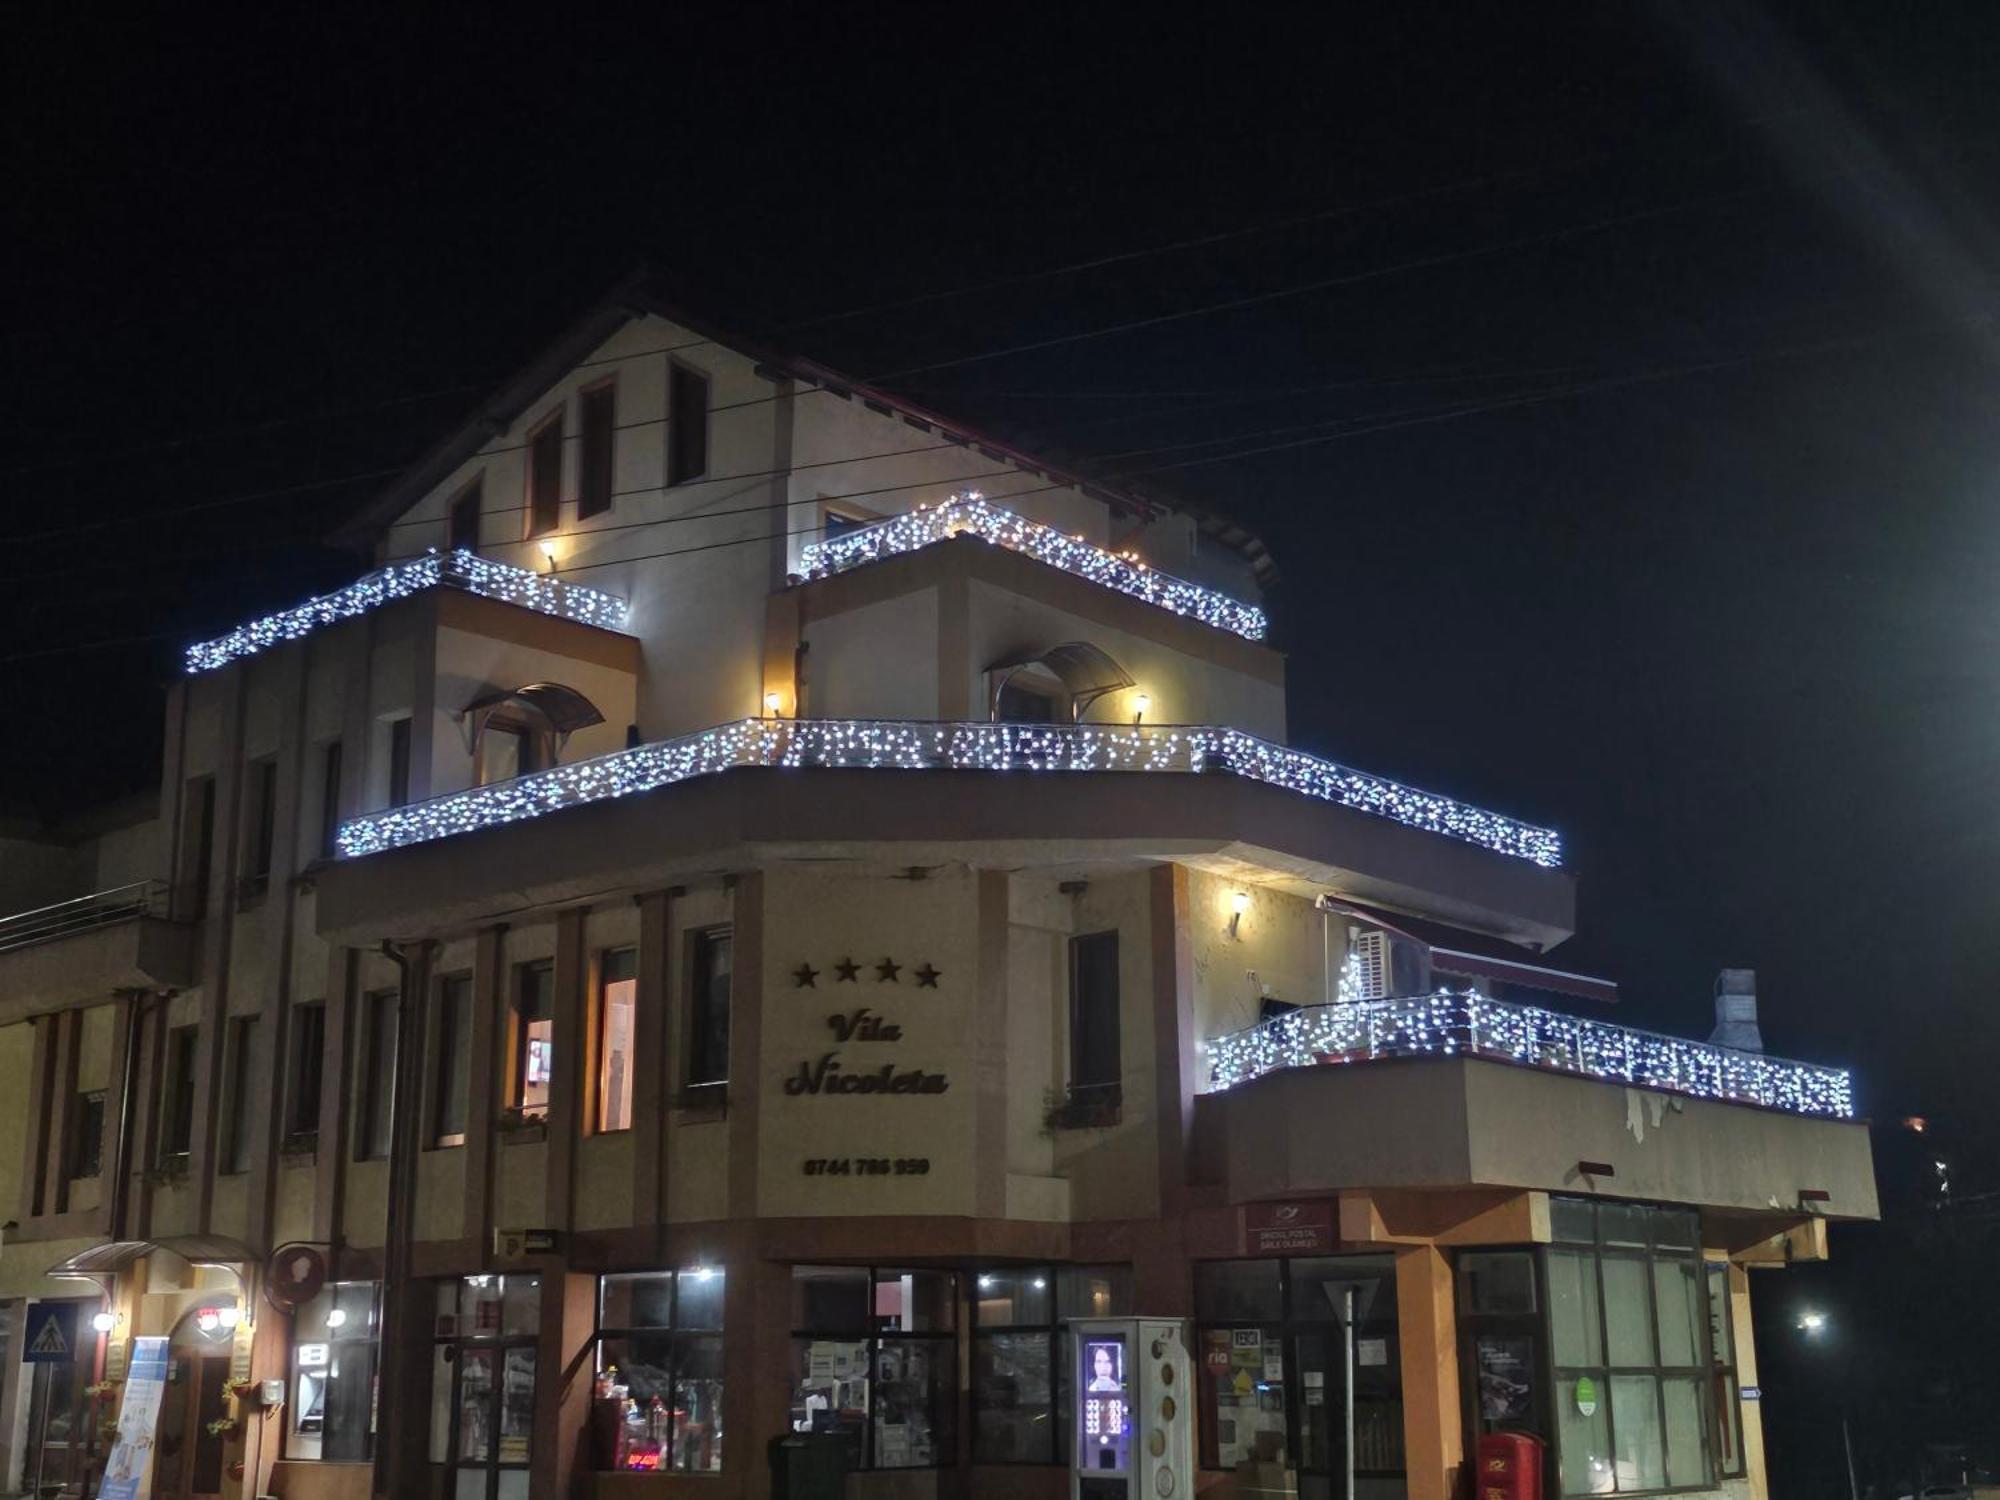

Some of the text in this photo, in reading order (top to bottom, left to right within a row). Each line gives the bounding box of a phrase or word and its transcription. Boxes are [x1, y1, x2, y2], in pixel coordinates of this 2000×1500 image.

[827, 1008, 903, 1042] Vila
[784, 1052, 949, 1095] Nicoleta
[803, 1158, 850, 1175] 0744
[1208, 1348, 1228, 1364] ria
